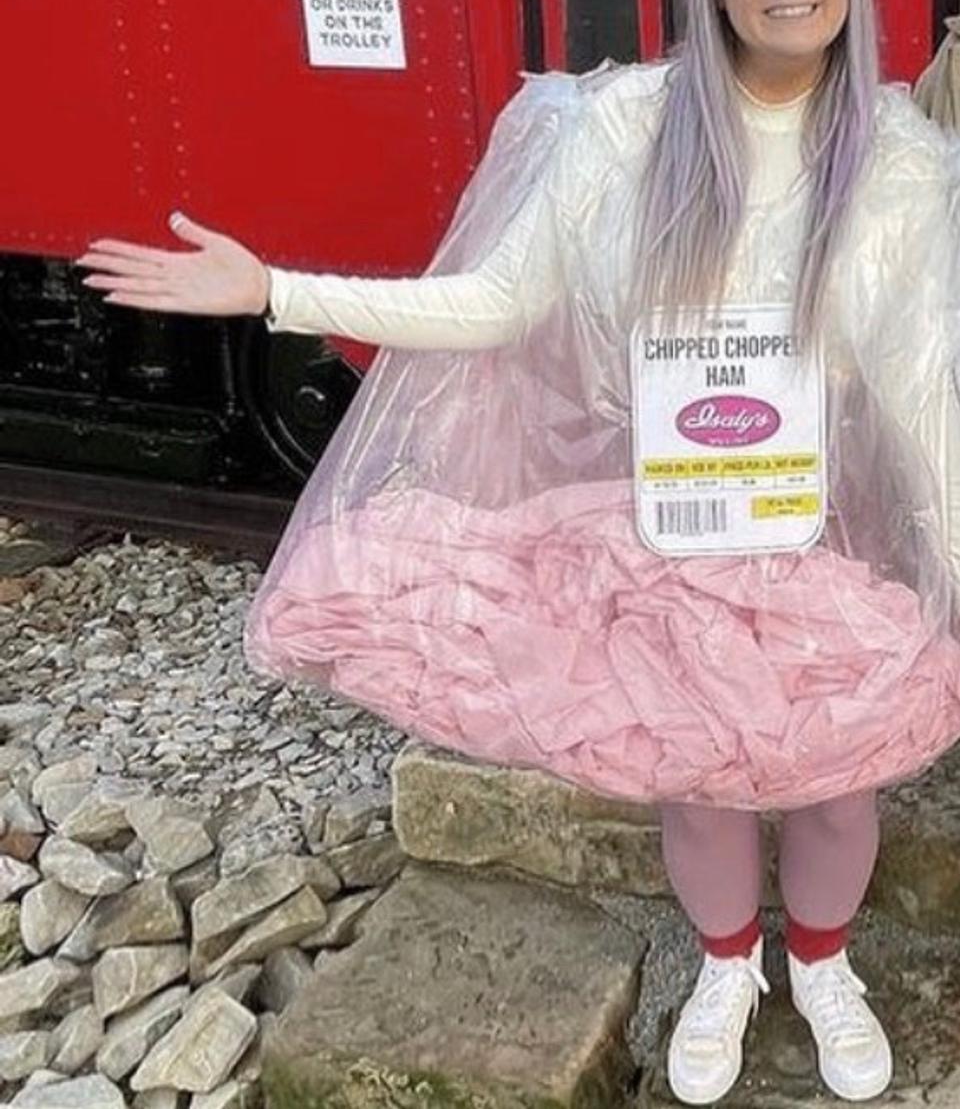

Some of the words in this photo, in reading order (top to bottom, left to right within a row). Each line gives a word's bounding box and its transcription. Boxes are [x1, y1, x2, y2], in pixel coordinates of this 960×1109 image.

[325, 15, 348, 29] ON
[352, 16, 383, 30] THE
[320, 32, 392, 48] TROLLEY
[644, 337, 720, 361] CHIPPED
[725, 335, 802, 358] CHOPPE
[706, 365, 746, 387] HAM
[684, 401, 768, 435] Isaly's
